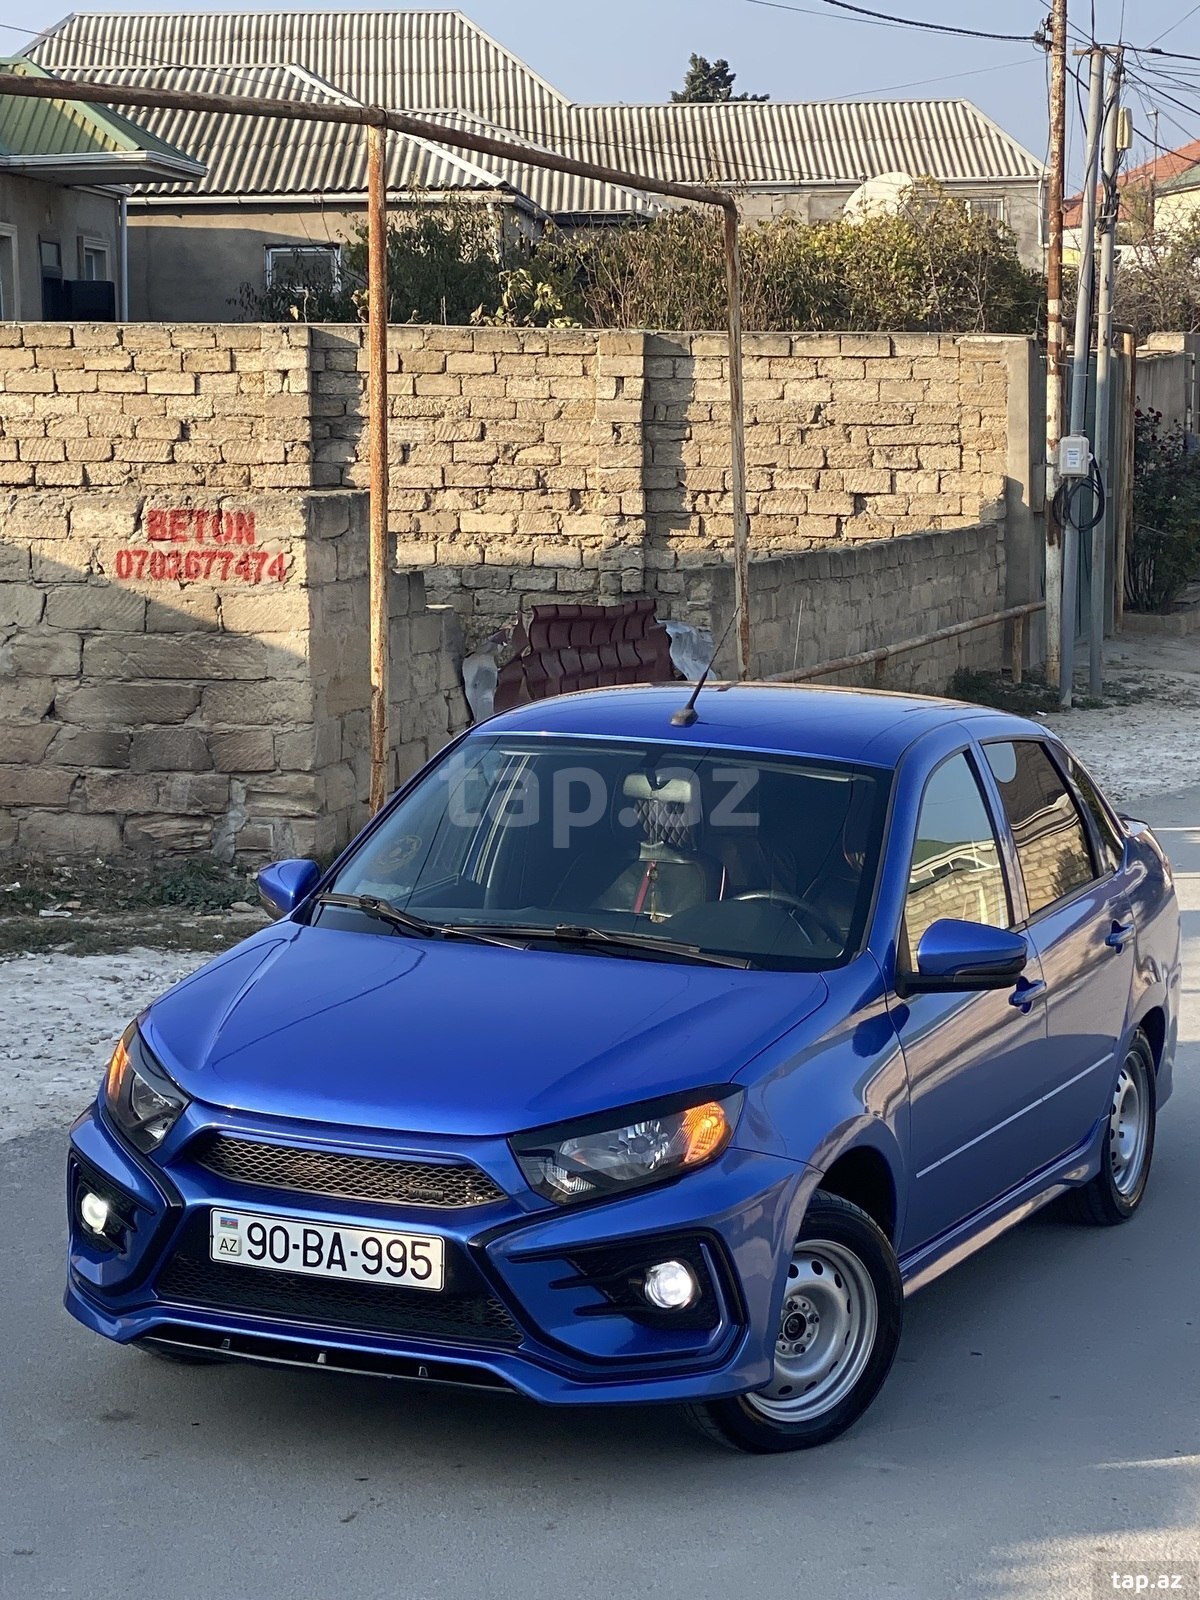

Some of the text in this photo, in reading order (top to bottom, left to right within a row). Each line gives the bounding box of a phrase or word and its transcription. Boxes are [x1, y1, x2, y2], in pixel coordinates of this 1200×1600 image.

[147, 508, 256, 545] BETON
[219, 1238, 237, 1253] AZ
[247, 1222, 432, 1280] 90-BA-995
